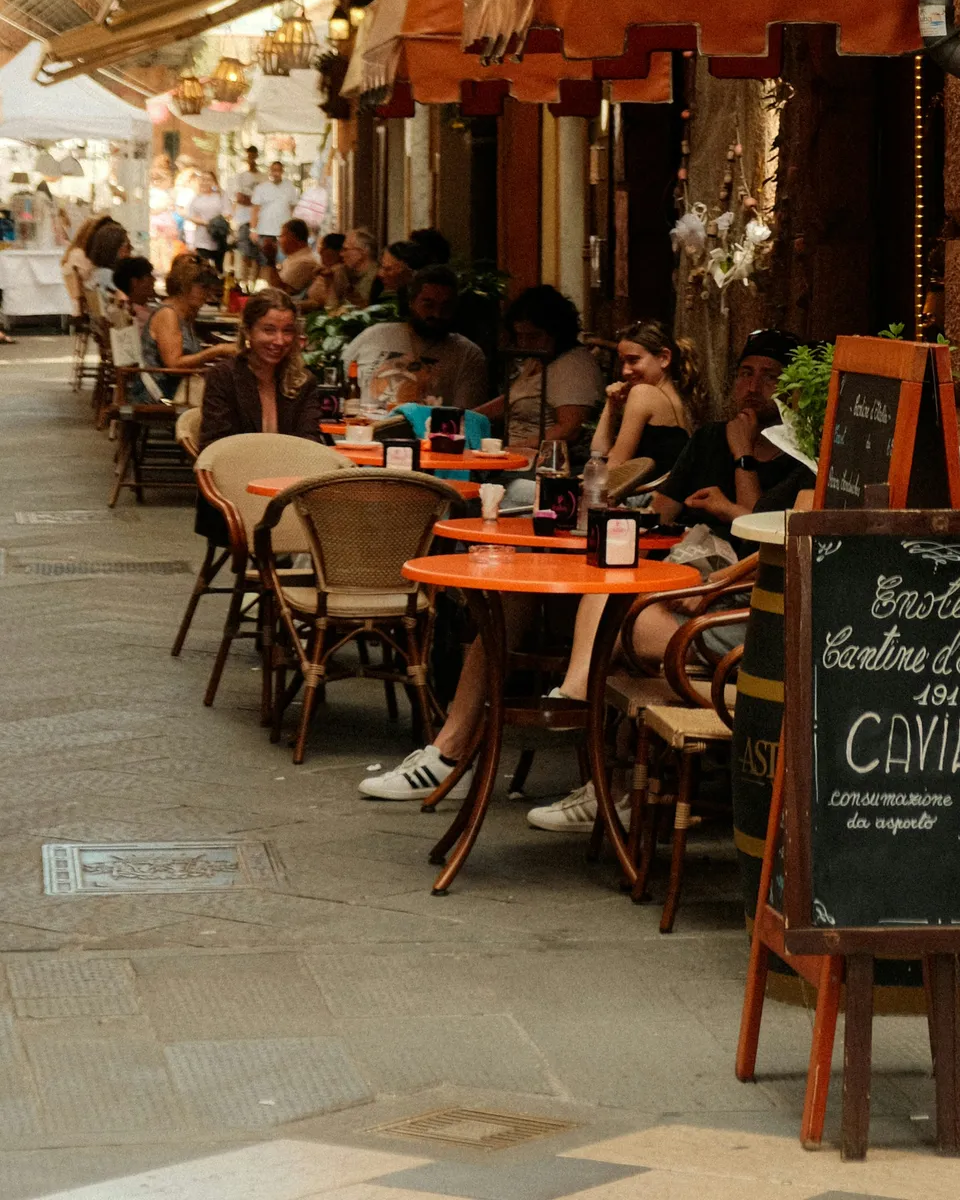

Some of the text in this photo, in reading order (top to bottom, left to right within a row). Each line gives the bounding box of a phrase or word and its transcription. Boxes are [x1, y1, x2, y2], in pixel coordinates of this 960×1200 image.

[822, 624, 929, 673] Cantine
[828, 787, 953, 807] consumazione
[846, 811, 871, 829] da
[875, 810, 938, 835] asporto
